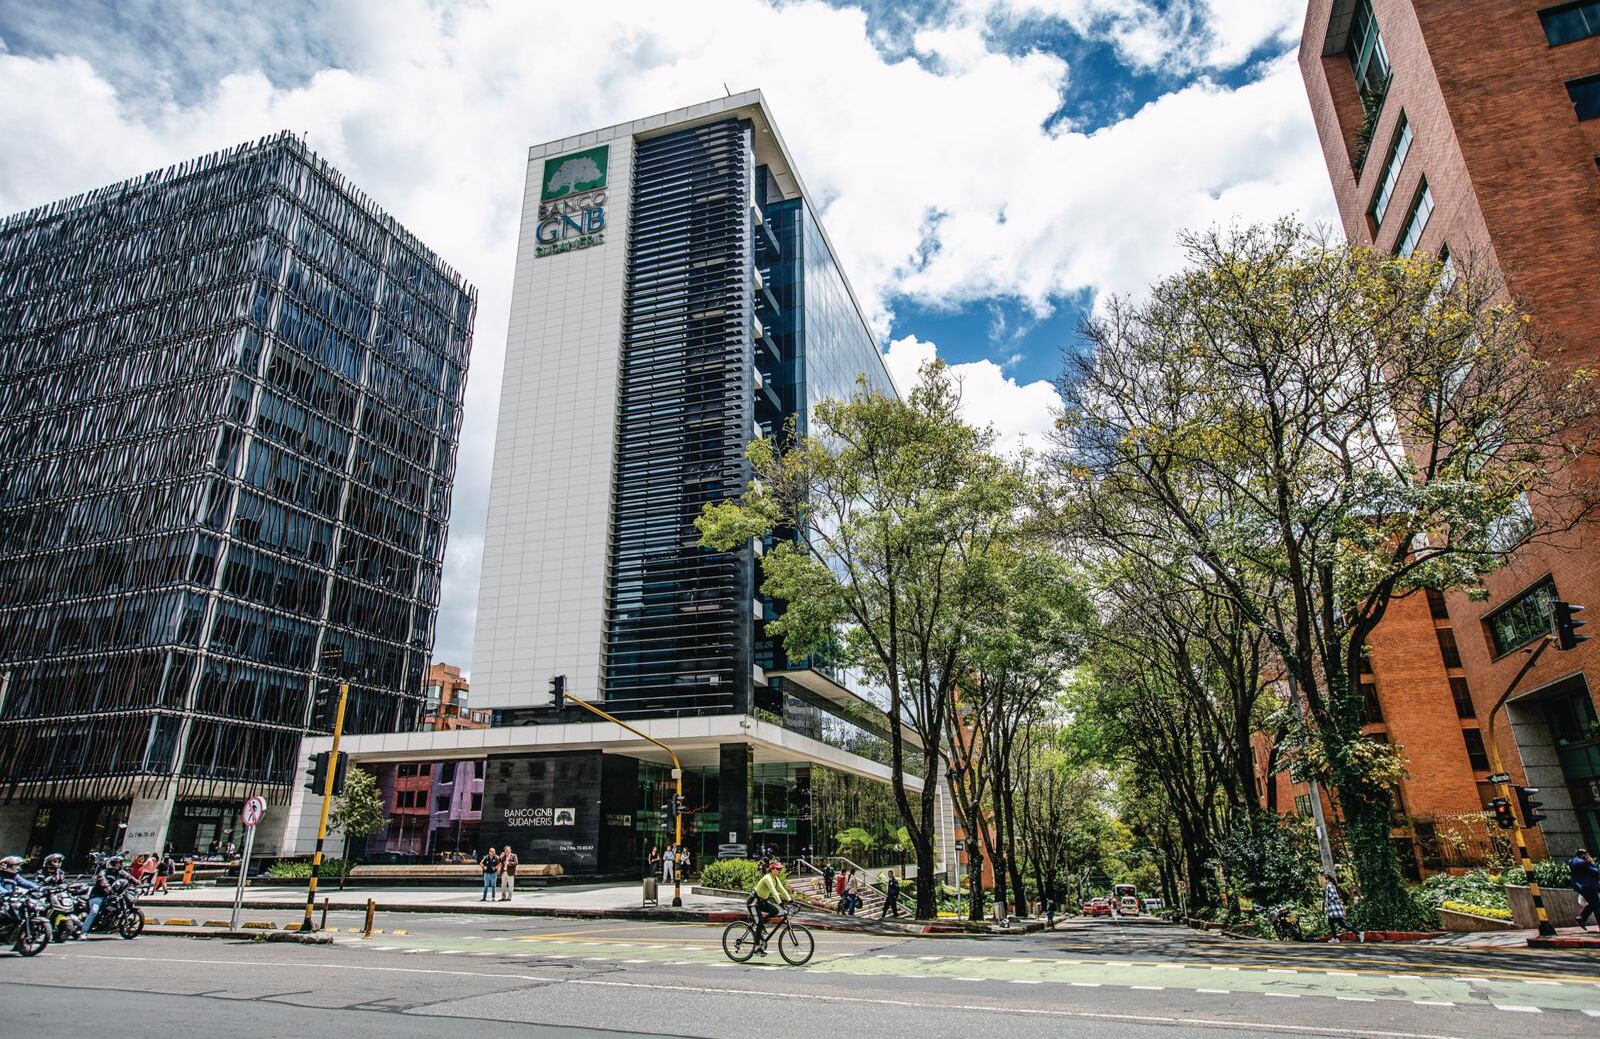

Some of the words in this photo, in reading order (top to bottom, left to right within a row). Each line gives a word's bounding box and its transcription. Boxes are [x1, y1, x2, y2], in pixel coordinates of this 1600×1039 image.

[538, 191, 608, 221] BANCO
[536, 207, 605, 244] GNB
[504, 808, 534, 817] BANCO
[534, 808, 553, 817] GNB
[508, 817, 553, 827] SUDAMERIS
